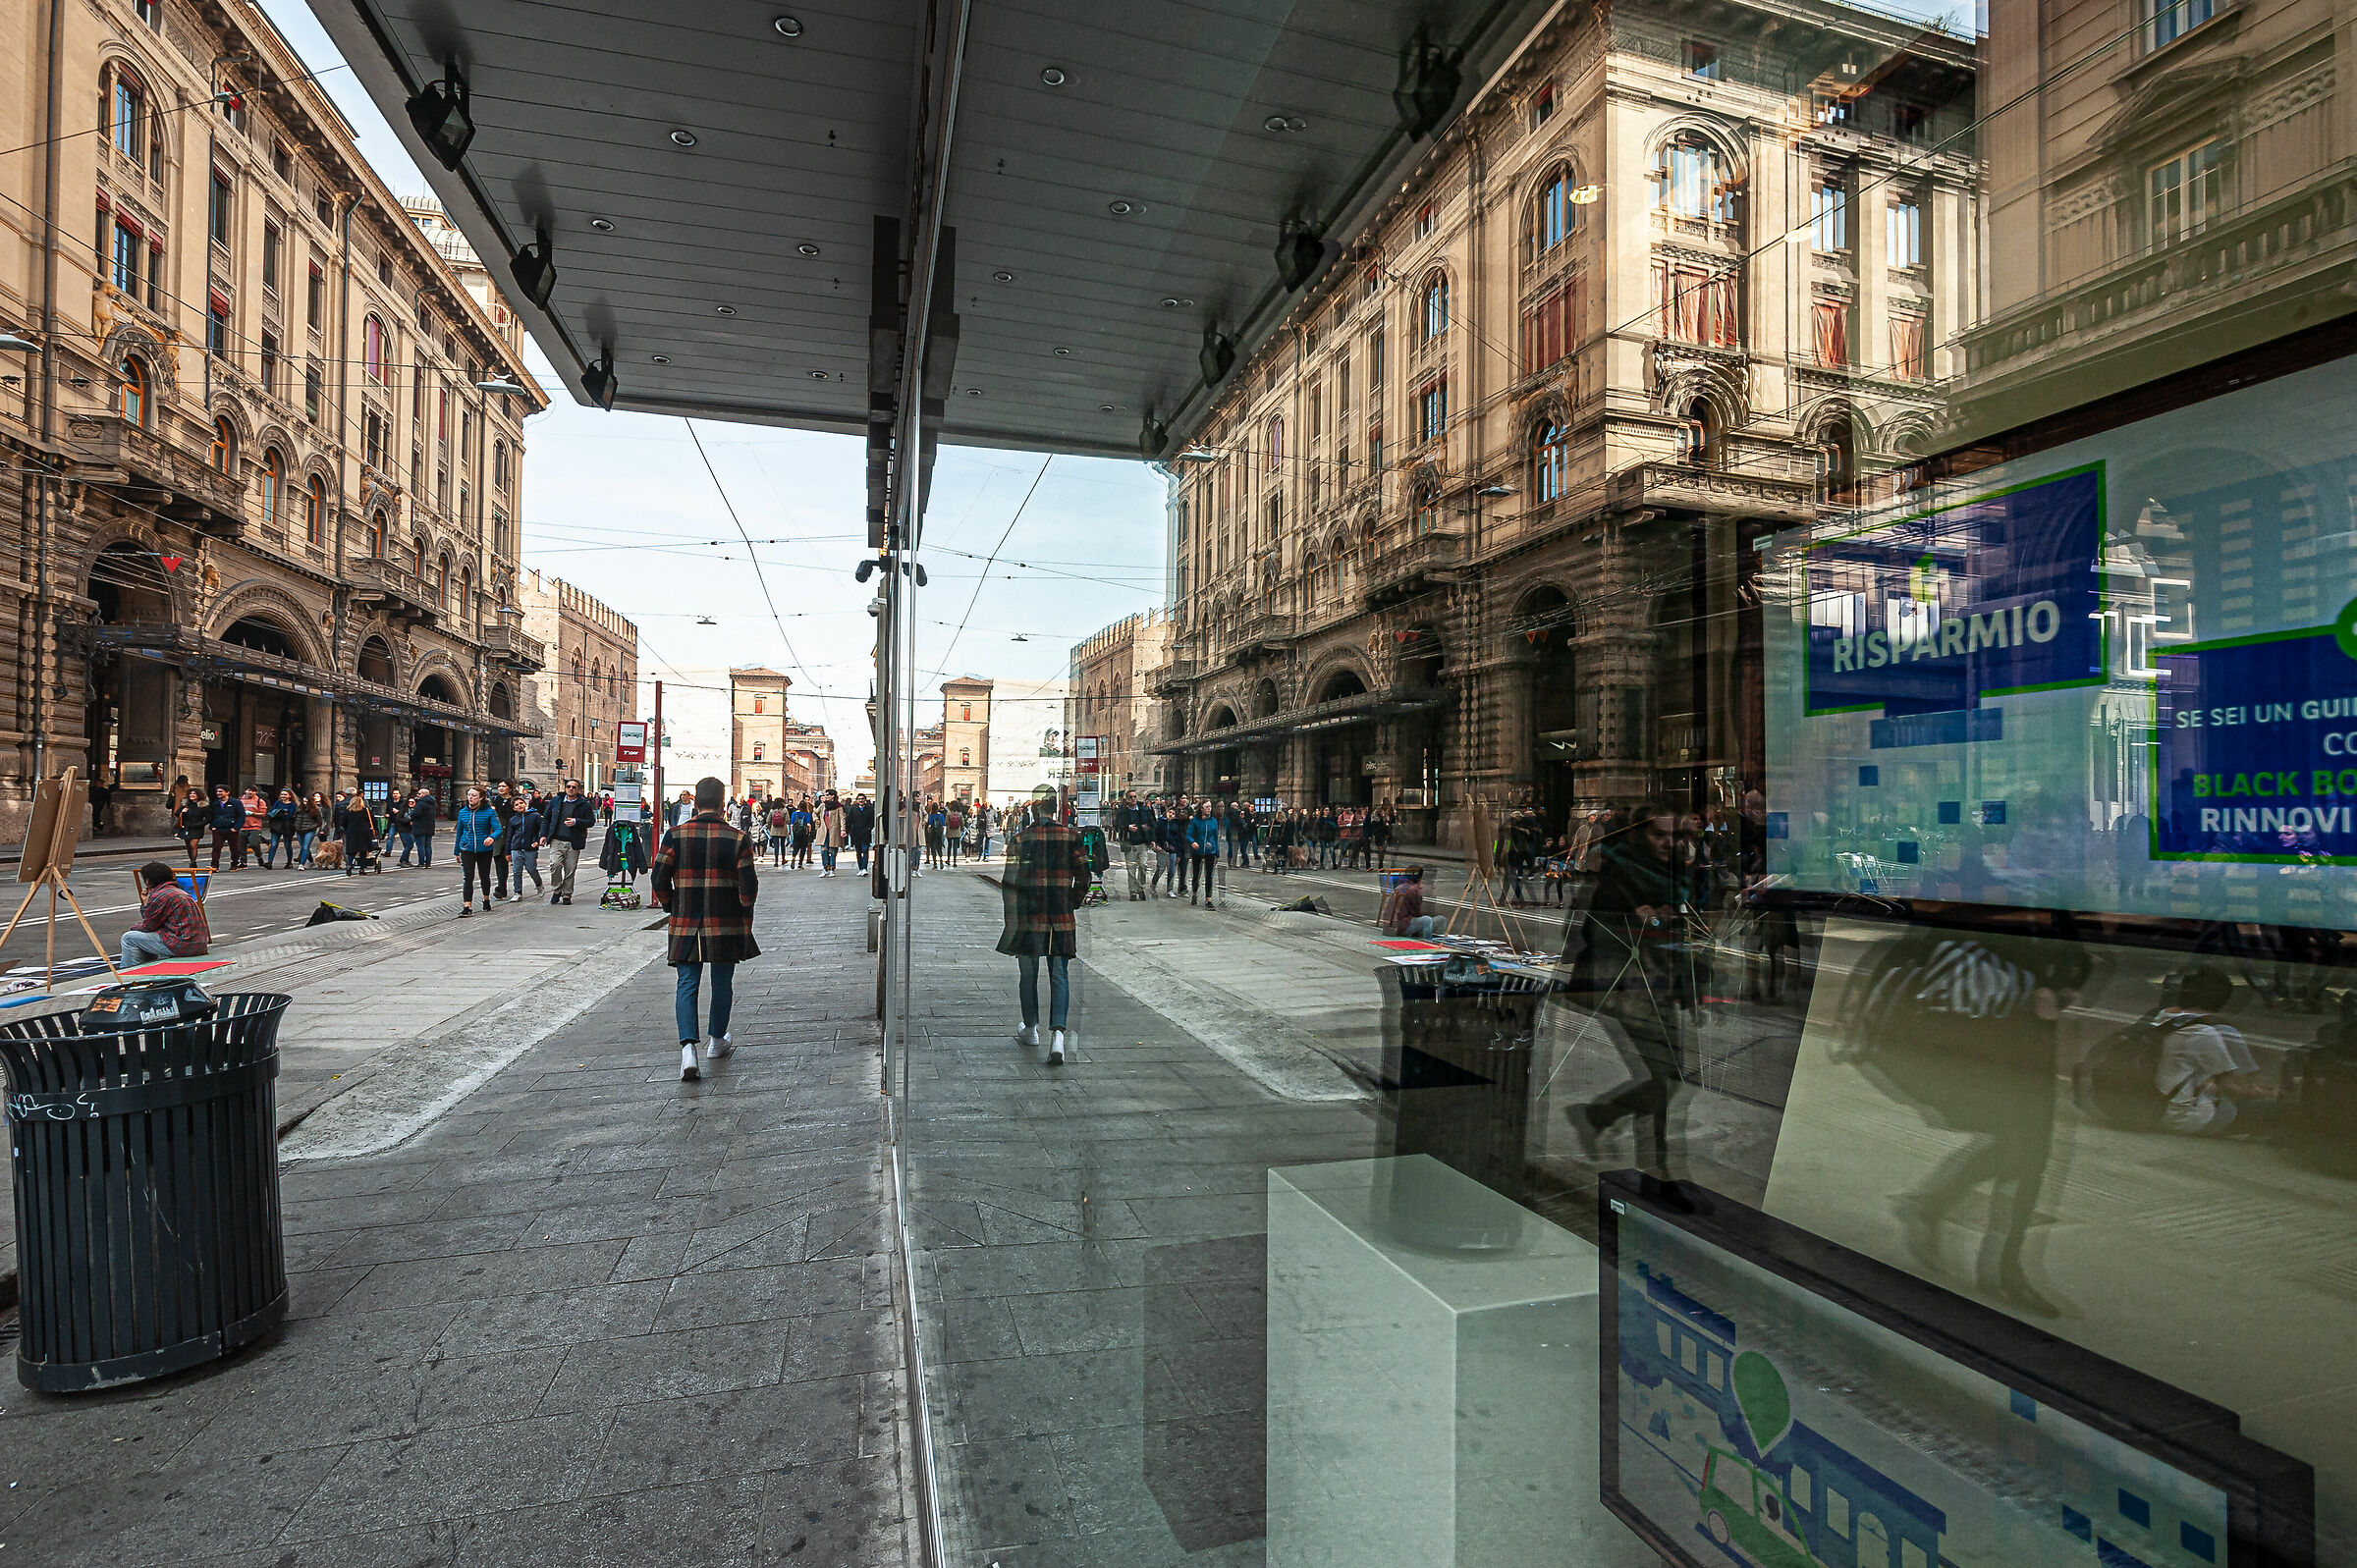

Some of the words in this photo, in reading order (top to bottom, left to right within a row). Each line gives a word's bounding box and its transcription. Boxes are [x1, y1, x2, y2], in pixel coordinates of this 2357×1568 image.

[1834, 600, 2060, 673] RISPARMIO
[2175, 710, 2204, 729] SE
[2210, 706, 2247, 727] SEI
[2254, 702, 2293, 724] UN
[2301, 697, 2357, 720] GUI
[200, 729, 215, 740] elio
[2193, 771, 2300, 797] BLACK
[2313, 769, 2357, 796] BO
[2201, 807, 2351, 834] RINNOVI
